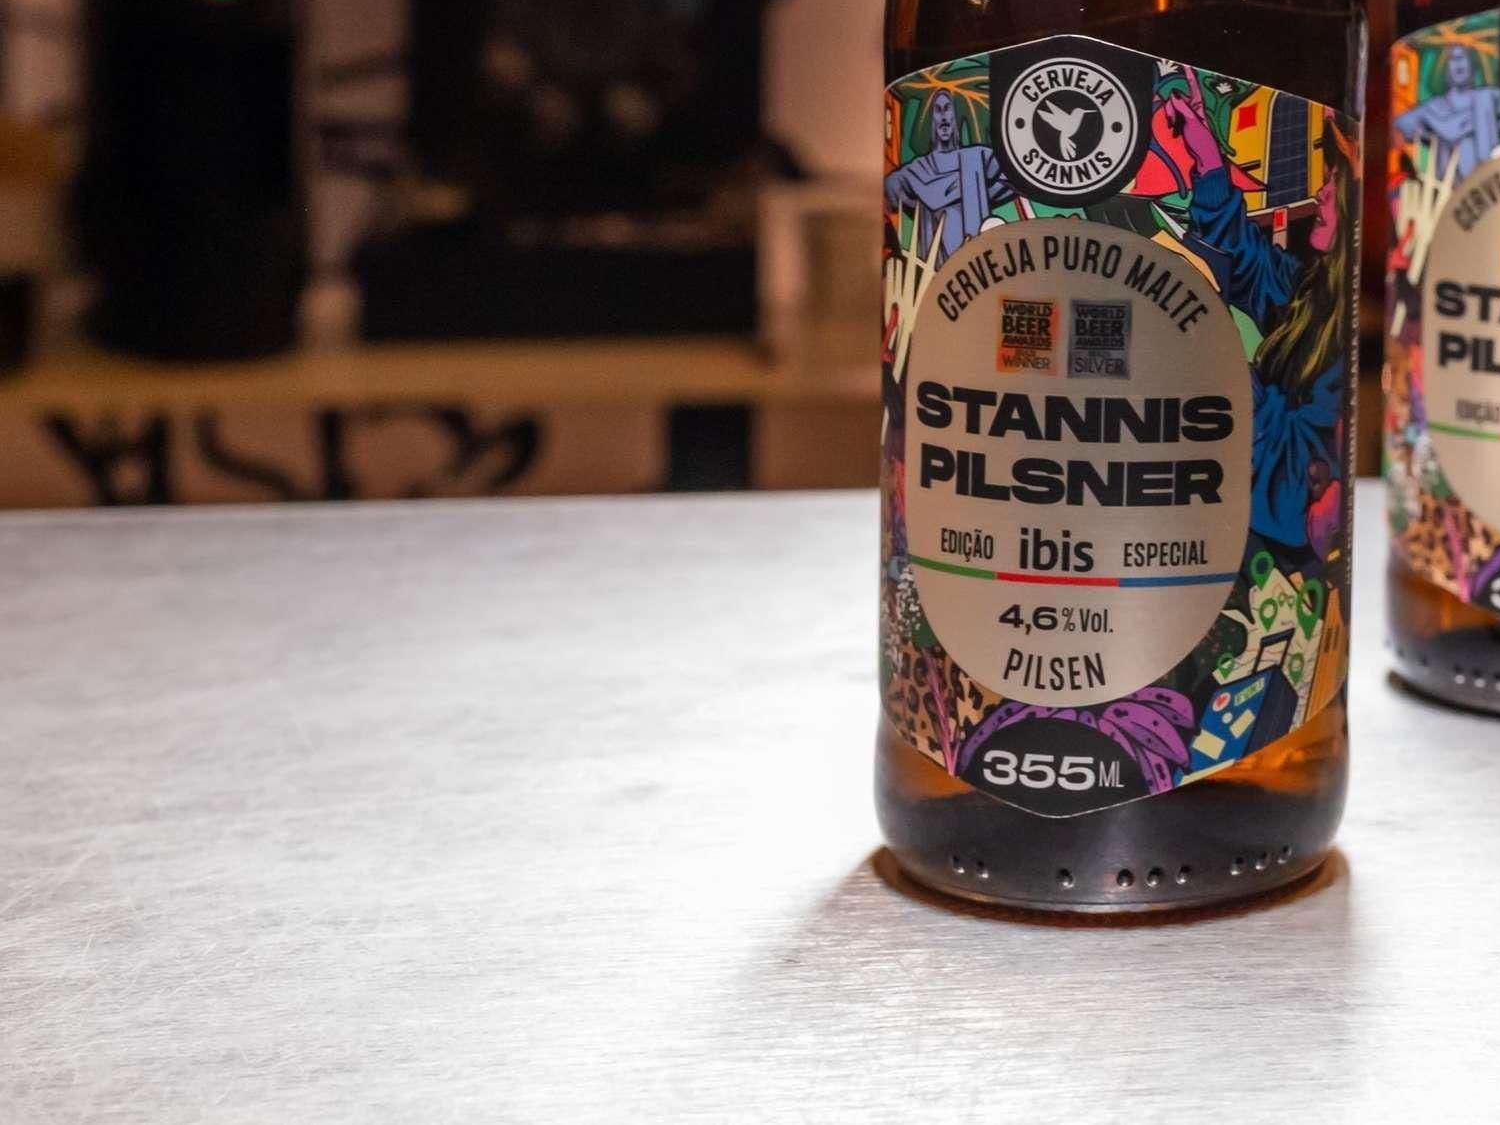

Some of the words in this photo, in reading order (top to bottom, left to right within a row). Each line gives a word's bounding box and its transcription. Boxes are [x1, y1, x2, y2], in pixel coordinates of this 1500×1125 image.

[1022, 68, 1115, 106] CERVEJA
[1023, 148, 1113, 184] STANNIS
[937, 241, 1035, 323] CERVEJA
[1044, 235, 1120, 278] PURO
[1124, 254, 1208, 334] MALTE
[1003, 303, 1053, 317] WORLD
[1075, 307, 1126, 319] WORLD
[1002, 316, 1051, 336] BEER
[1075, 318, 1124, 337] BEER
[1001, 335, 1053, 347] AWARDS
[1001, 355, 1051, 370] WINNER
[1074, 357, 1125, 374] SILVER
[916, 381, 1234, 443] STANNIS
[919, 443, 1225, 507] PILSNER
[941, 528, 994, 563] EDIÇÃO
[1019, 527, 1094, 573] ibis
[1123, 540, 1208, 567] ESPECIAL
[1003, 648, 1106, 691] PILSEN
